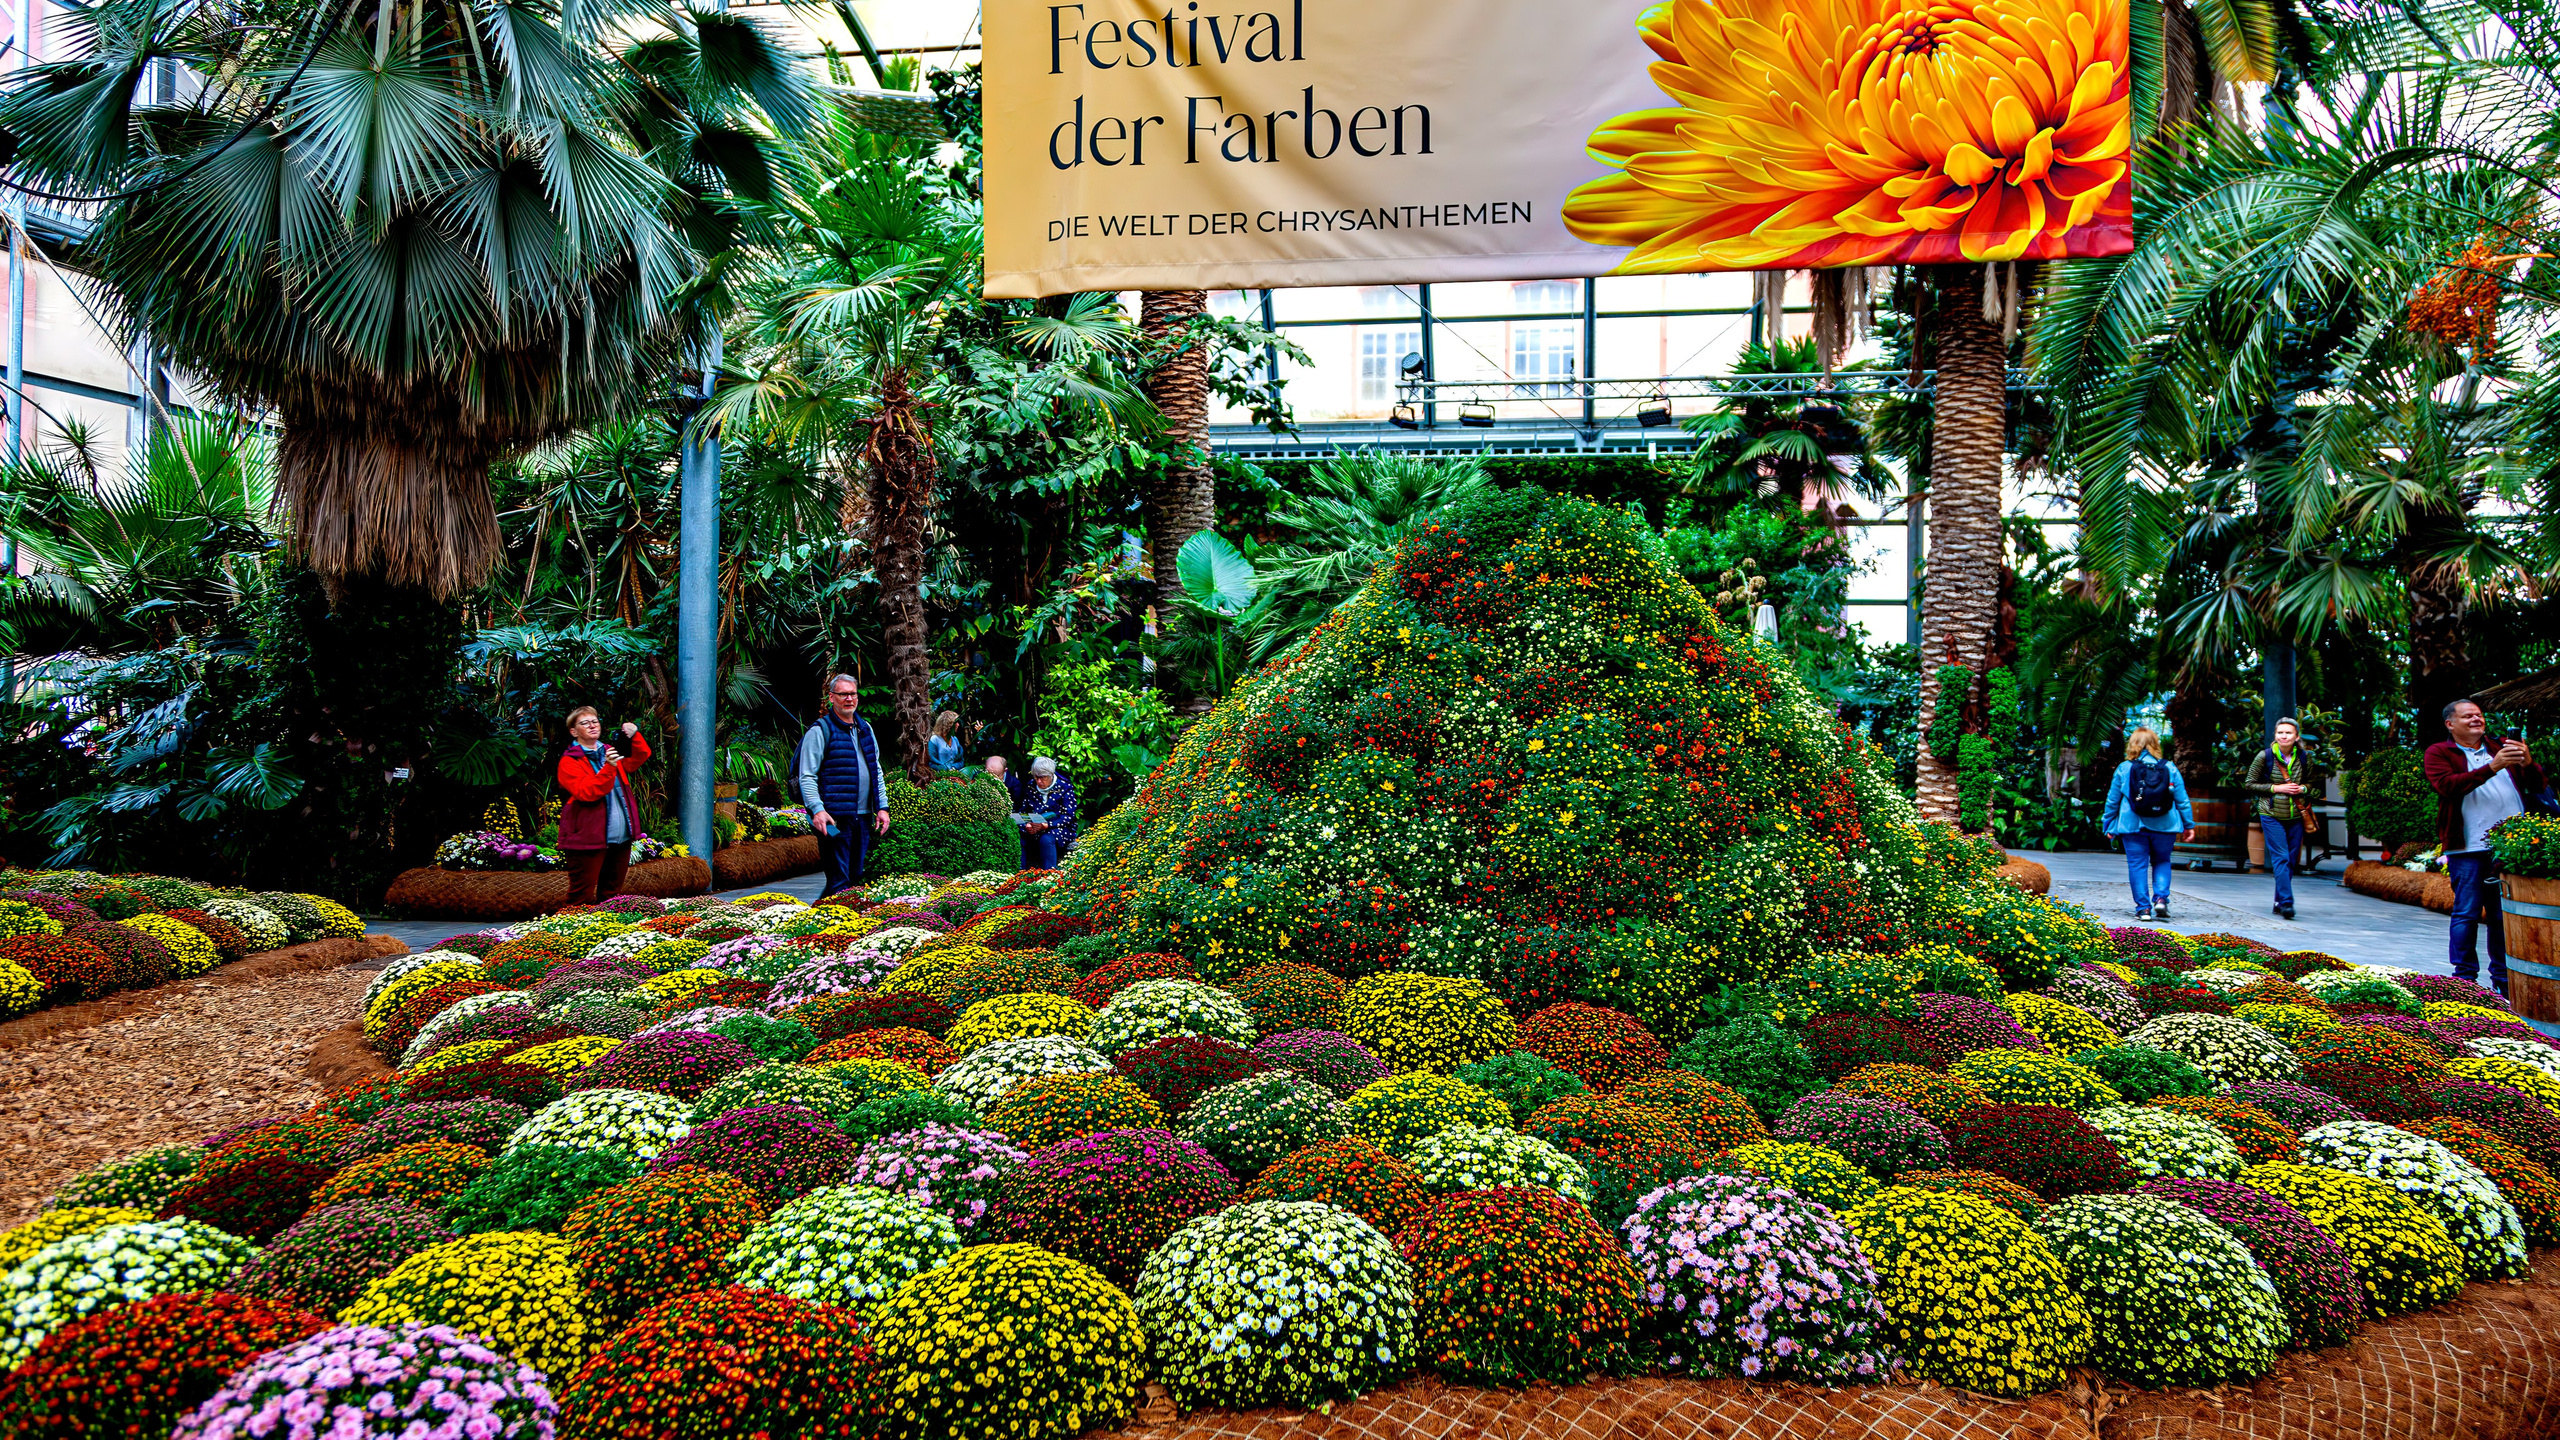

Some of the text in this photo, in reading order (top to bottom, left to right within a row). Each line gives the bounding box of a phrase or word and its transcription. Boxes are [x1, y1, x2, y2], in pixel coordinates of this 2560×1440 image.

[1047, 0, 1306, 75] Festival
[1048, 84, 1434, 170] der Farben
[1048, 201, 1532, 242] DIE WELT DER CHRYSANTHEMEN
